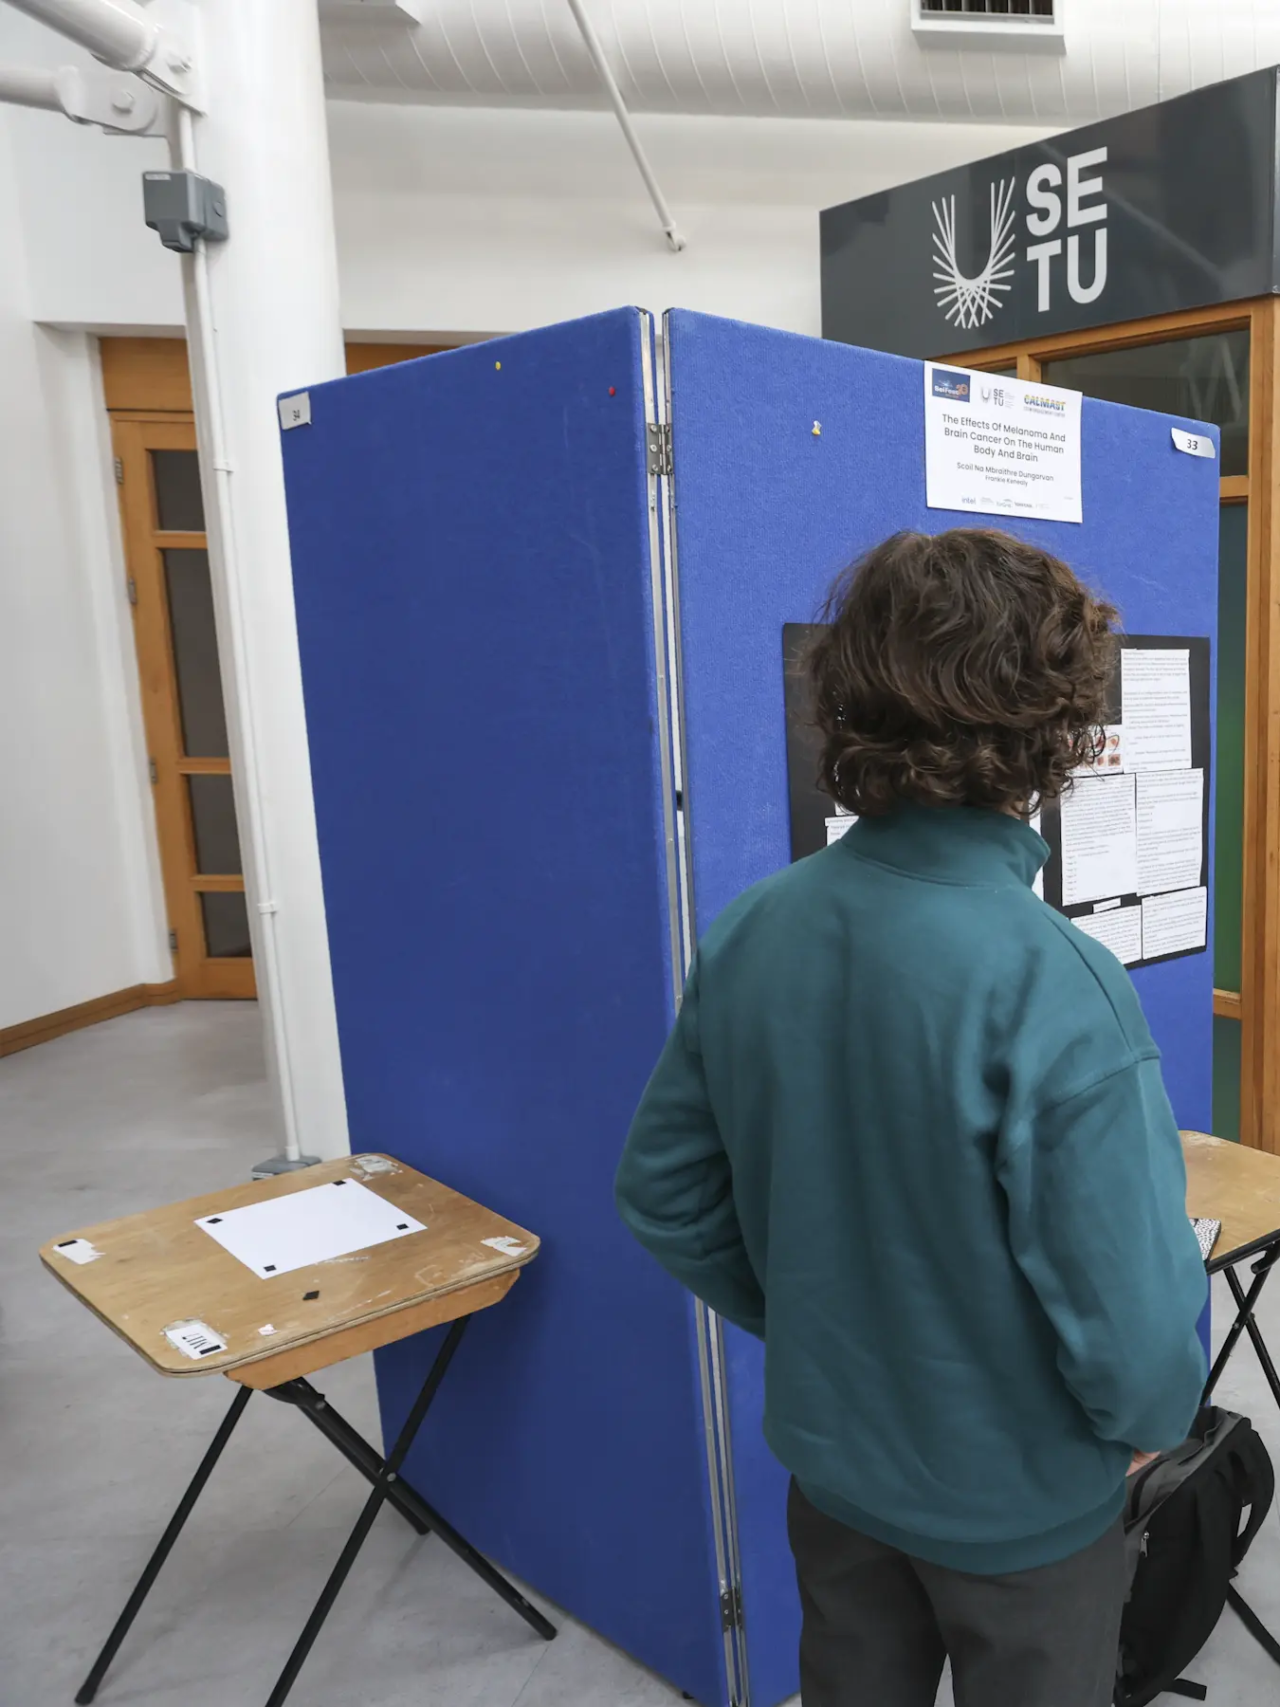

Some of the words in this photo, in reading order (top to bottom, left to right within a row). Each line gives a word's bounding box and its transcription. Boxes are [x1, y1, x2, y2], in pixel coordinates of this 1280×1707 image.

[1026, 146, 1107, 236] SE
[1026, 227, 1107, 312] TU
[942, 414, 958, 424] The
[961, 417, 989, 430] Effects
[992, 422, 1001, 431] Of
[1004, 425, 1048, 440] Melanoma
[1050, 434, 1066, 442] And
[944, 428, 968, 438] Brain
[970, 432, 1002, 444] Cancer
[1004, 437, 1016, 446] On
[1018, 440, 1032, 448] The
[1034, 442, 1064, 454] Human
[974, 445, 995, 458] Body
[998, 449, 1014, 459] And
[1017, 451, 1038, 462] Brain
[1187, 438, 1198, 450] 33
[1019, 470, 1054, 481] Dungarvan
